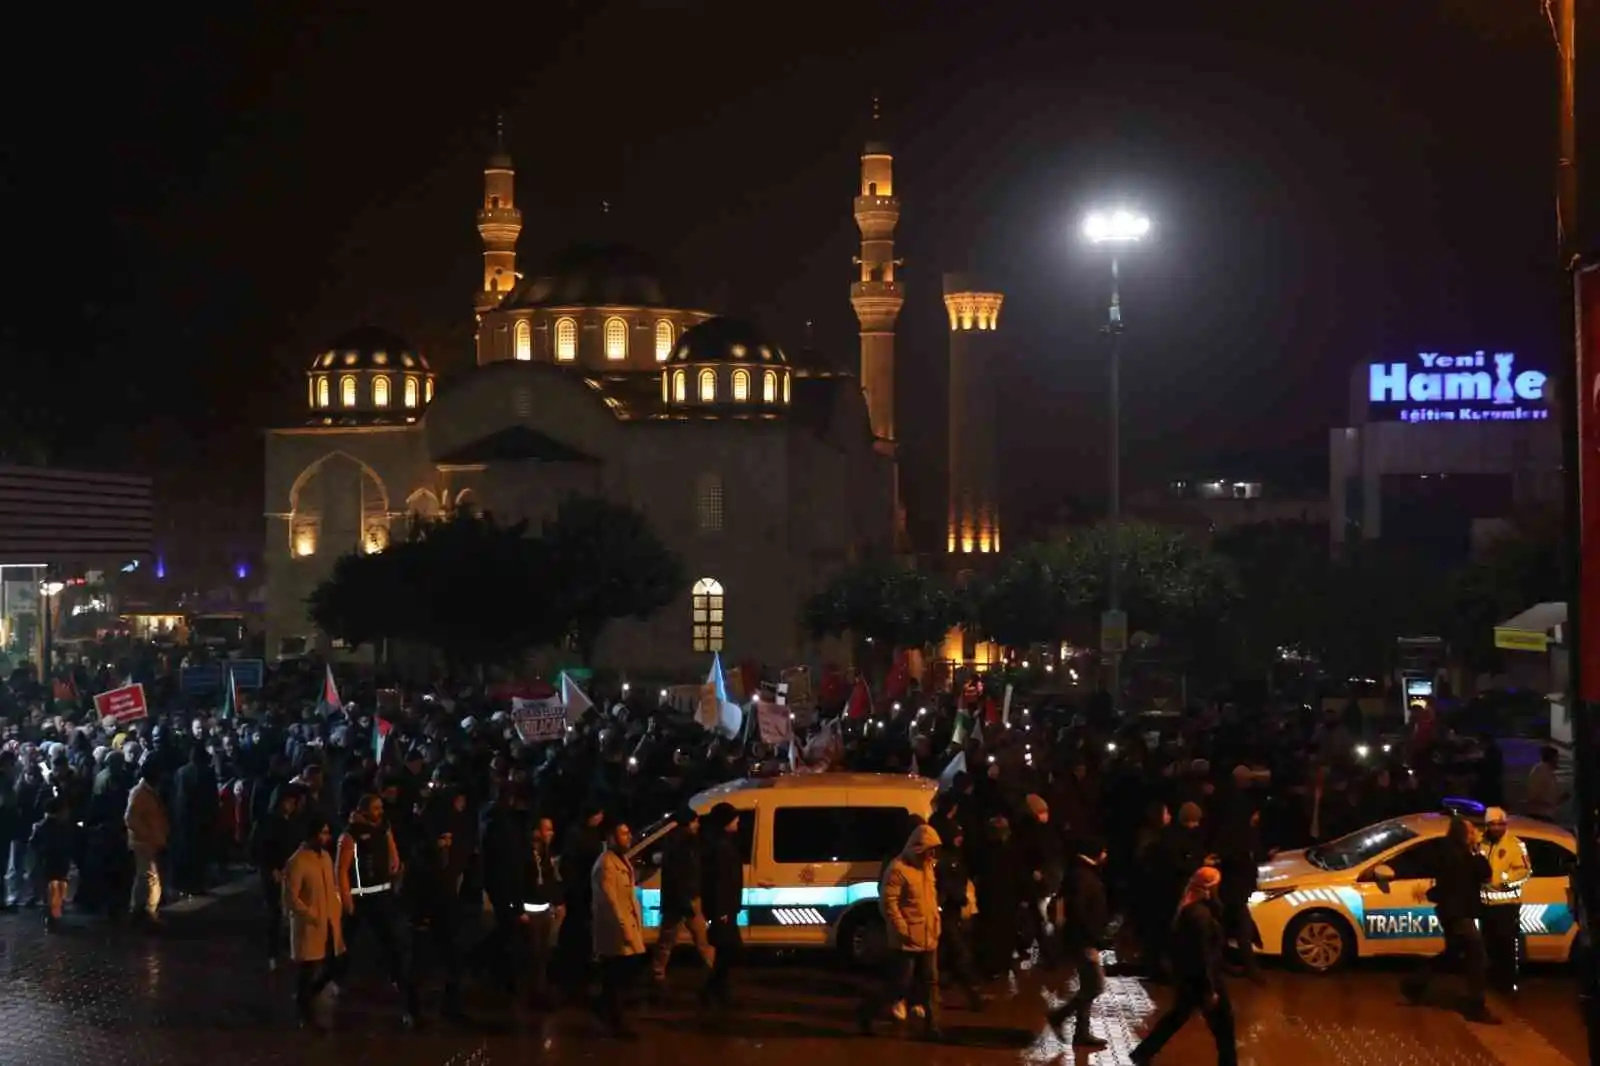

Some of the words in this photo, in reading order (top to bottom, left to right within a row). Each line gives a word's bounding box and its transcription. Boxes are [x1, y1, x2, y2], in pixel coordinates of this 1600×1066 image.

[1419, 351, 1484, 367] Yeni
[1400, 408, 1455, 423] Eğitim
[1366, 911, 1423, 932] TRAFİK
